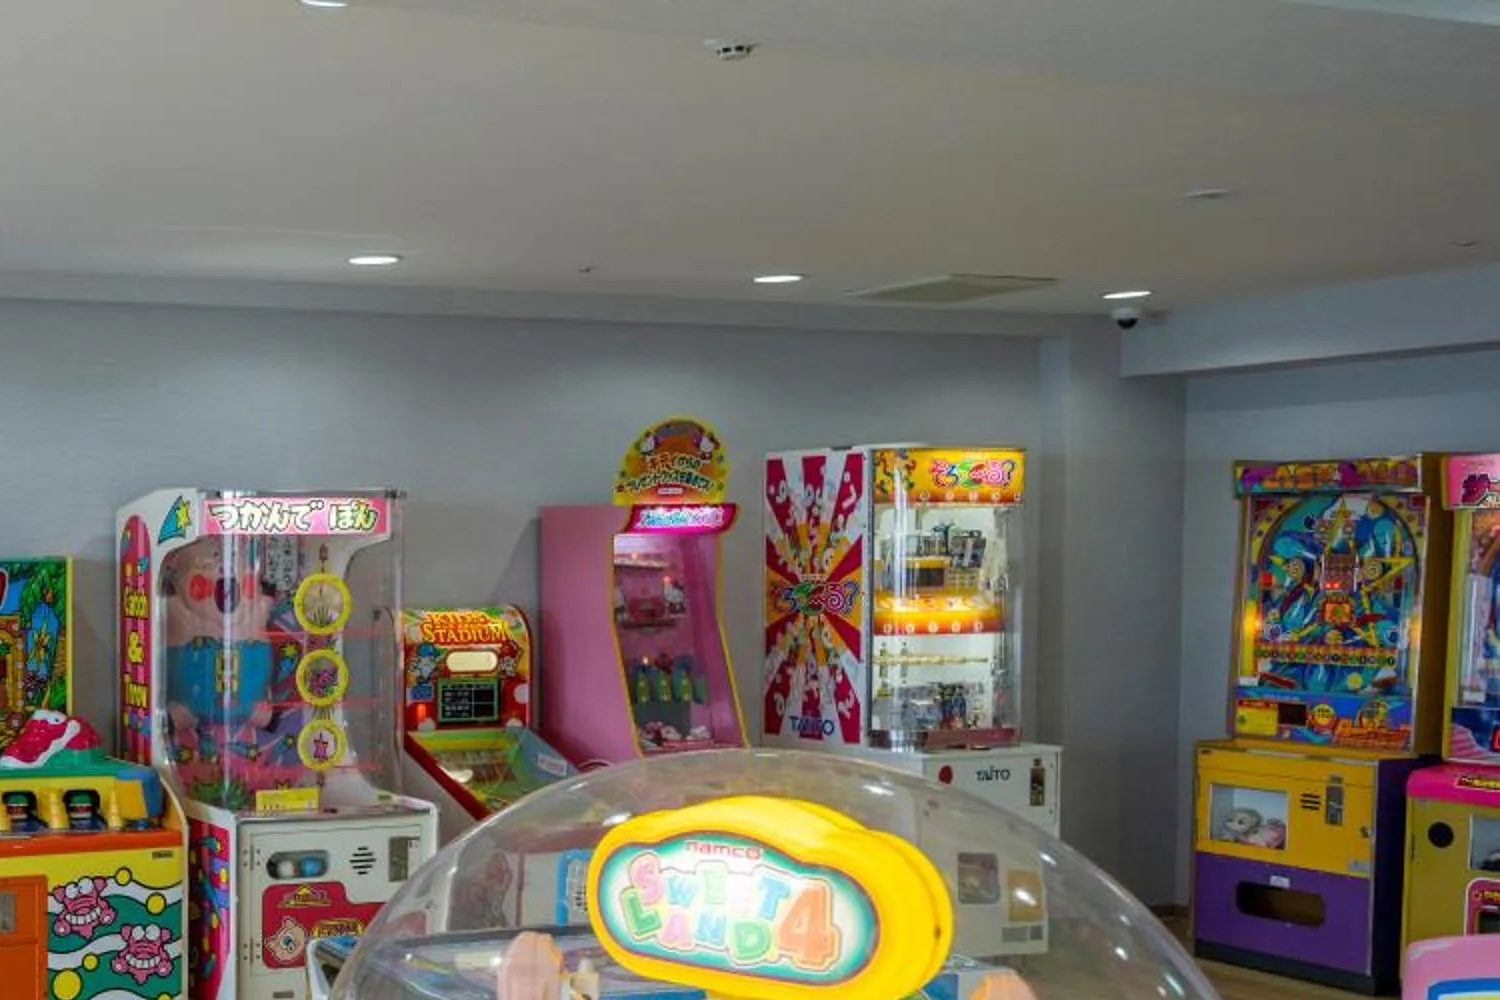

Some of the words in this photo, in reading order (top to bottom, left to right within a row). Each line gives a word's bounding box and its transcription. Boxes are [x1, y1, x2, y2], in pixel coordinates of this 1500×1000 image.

[210, 500, 324, 531] つかんで
[421, 622, 509, 643] STADIUM
[128, 630, 146, 664] &
[788, 715, 836, 736] TAITO
[976, 765, 1011, 781] TAITO
[685, 840, 762, 861] namco
[620, 885, 777, 964] LAND
[776, 878, 843, 972] 4
